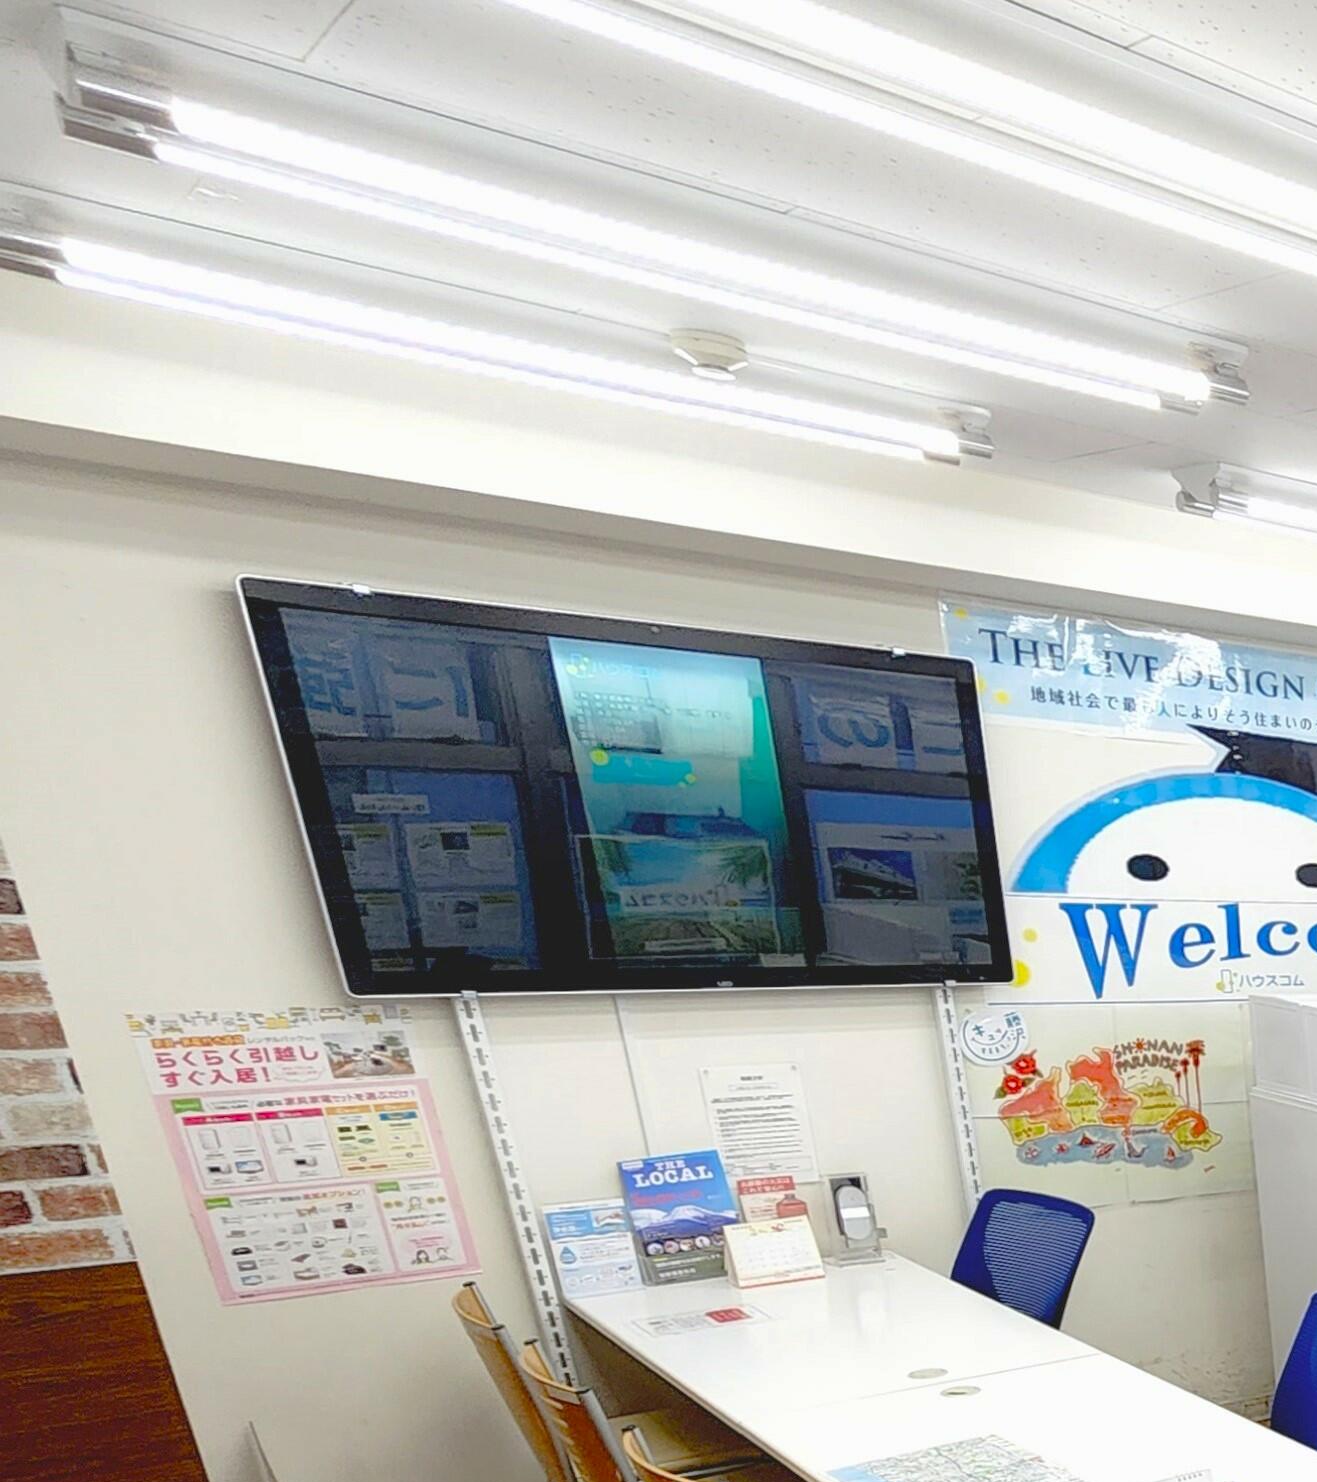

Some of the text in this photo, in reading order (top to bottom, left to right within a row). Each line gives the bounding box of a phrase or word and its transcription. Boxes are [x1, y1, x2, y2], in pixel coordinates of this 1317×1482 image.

[1177, 656, 1305, 702] DESIGN
[1239, 973, 1305, 989] ハウスコム
[154, 1045, 319, 1069] らくらく引越し
[654, 1159, 686, 1170] THE
[632, 1165, 714, 1188] LOCAL
